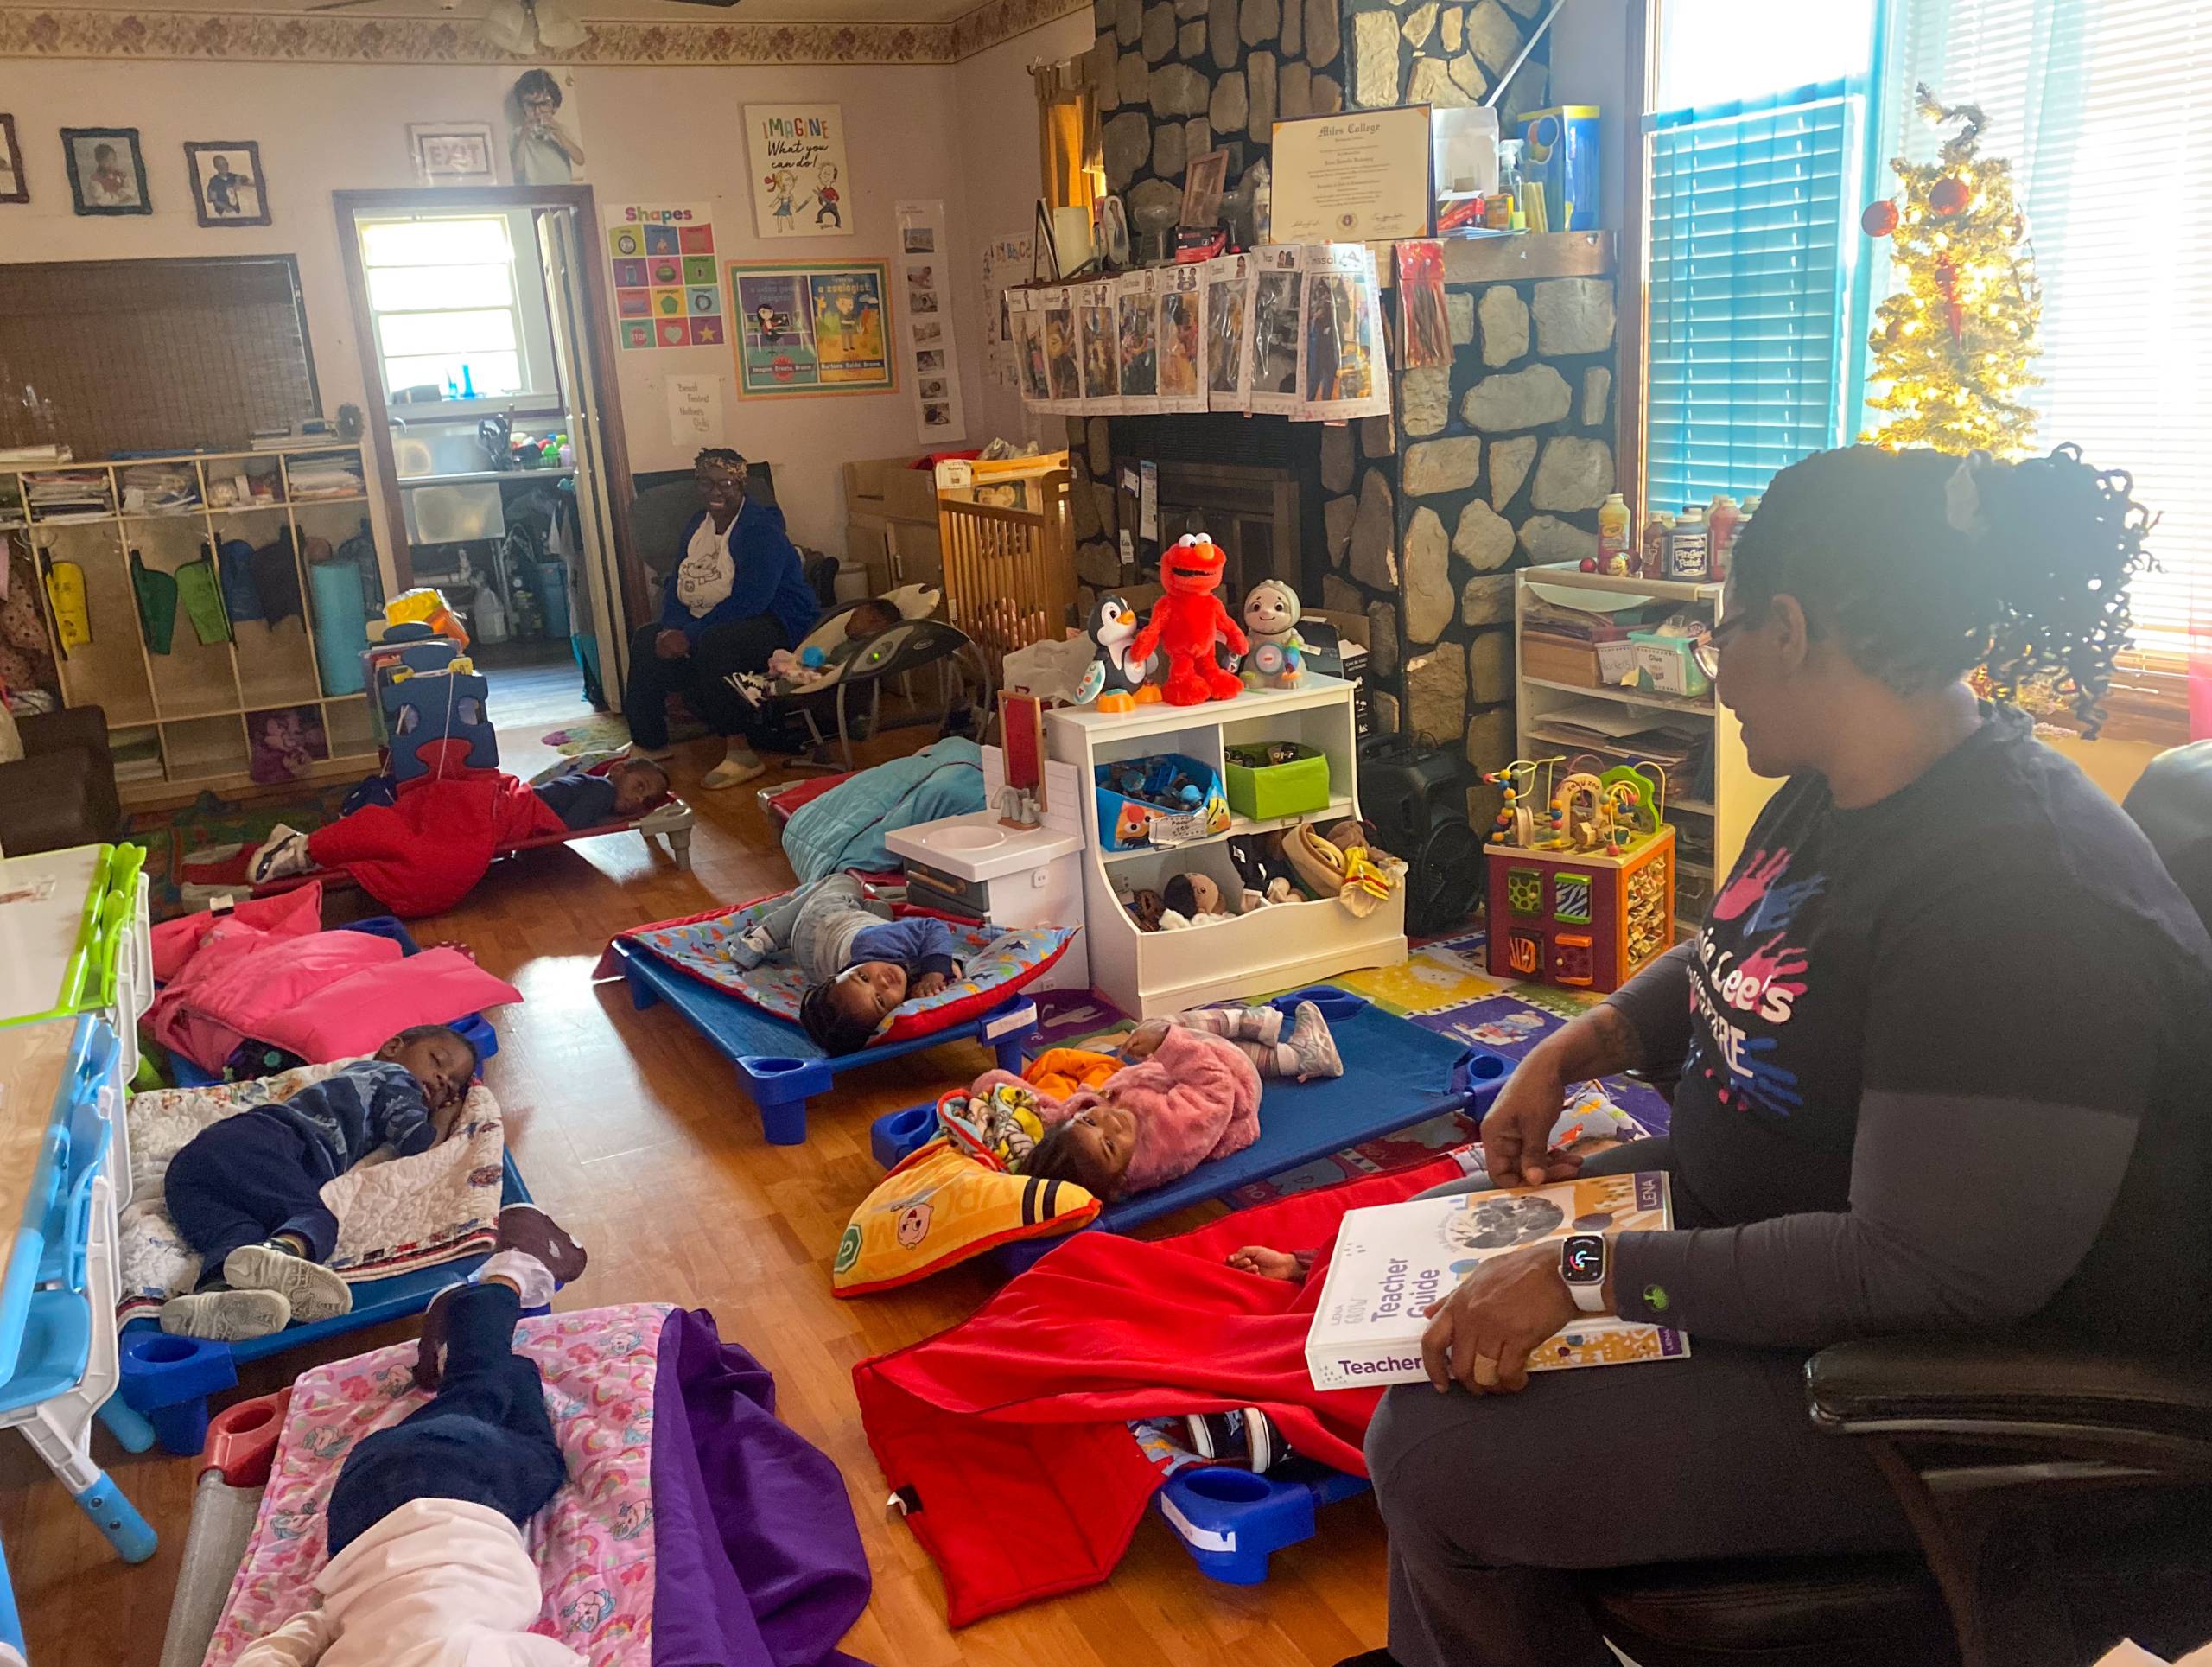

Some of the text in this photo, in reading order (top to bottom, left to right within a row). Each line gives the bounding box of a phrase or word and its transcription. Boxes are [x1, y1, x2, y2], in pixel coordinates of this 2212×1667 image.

[762, 118, 830, 139] IMAGINE
[1318, 123, 1381, 137] Miles College
[767, 140, 829, 160] What you
[796, 155, 818, 169] do!
[625, 206, 693, 224] Shapes
[827, 283, 871, 295] zoologist
[1675, 549, 1705, 561] Finger
[1679, 558, 1702, 568] Paint
[1649, 654, 1662, 663] Glue
[1588, 780, 1599, 790] zoo
[1710, 951, 1794, 1023] Lee's
[1643, 1179, 1656, 1207] LENA
[1371, 1257, 1409, 1323] Teacher
[1407, 1269, 1440, 1319] Guide
[1330, 1303, 1344, 1326] LENA
[1344, 1296, 1367, 1326] GROW
[1664, 1328, 1676, 1350] LENA
[1338, 1356, 1422, 1377] Teacher
